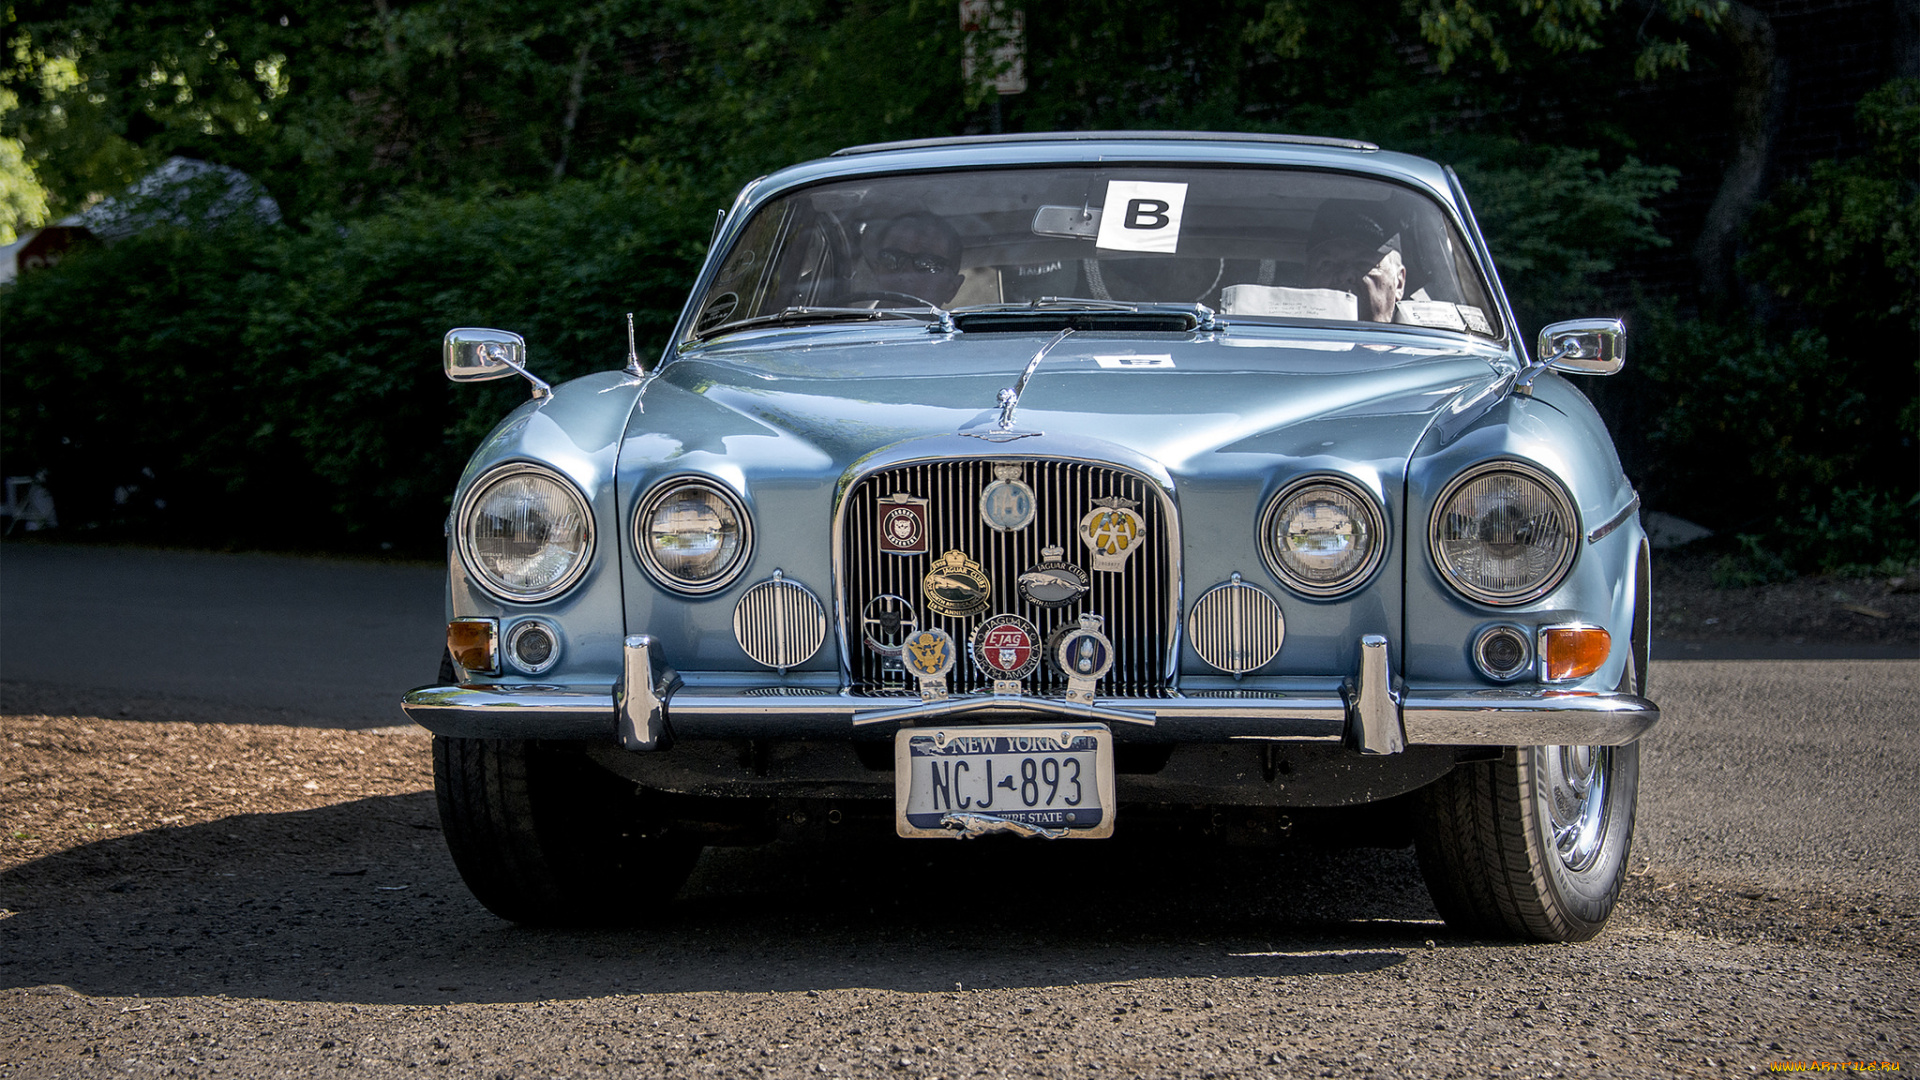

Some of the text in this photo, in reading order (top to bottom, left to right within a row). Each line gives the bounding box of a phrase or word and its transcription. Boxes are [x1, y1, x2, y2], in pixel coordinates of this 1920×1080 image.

[1124, 198, 1170, 230] B
[942, 567, 986, 588] JAGUAR CLUBS
[1037, 562, 1088, 584] JAGUAR CLUBS
[930, 590, 946, 605] NORTH
[1025, 594, 1044, 606] NORTH
[985, 616, 1030, 633] JAGUAR
[974, 642, 1040, 680] NORTH AMERICA
[952, 737, 1061, 754] NEW YORK
[1028, 812, 1063, 824] STATE
